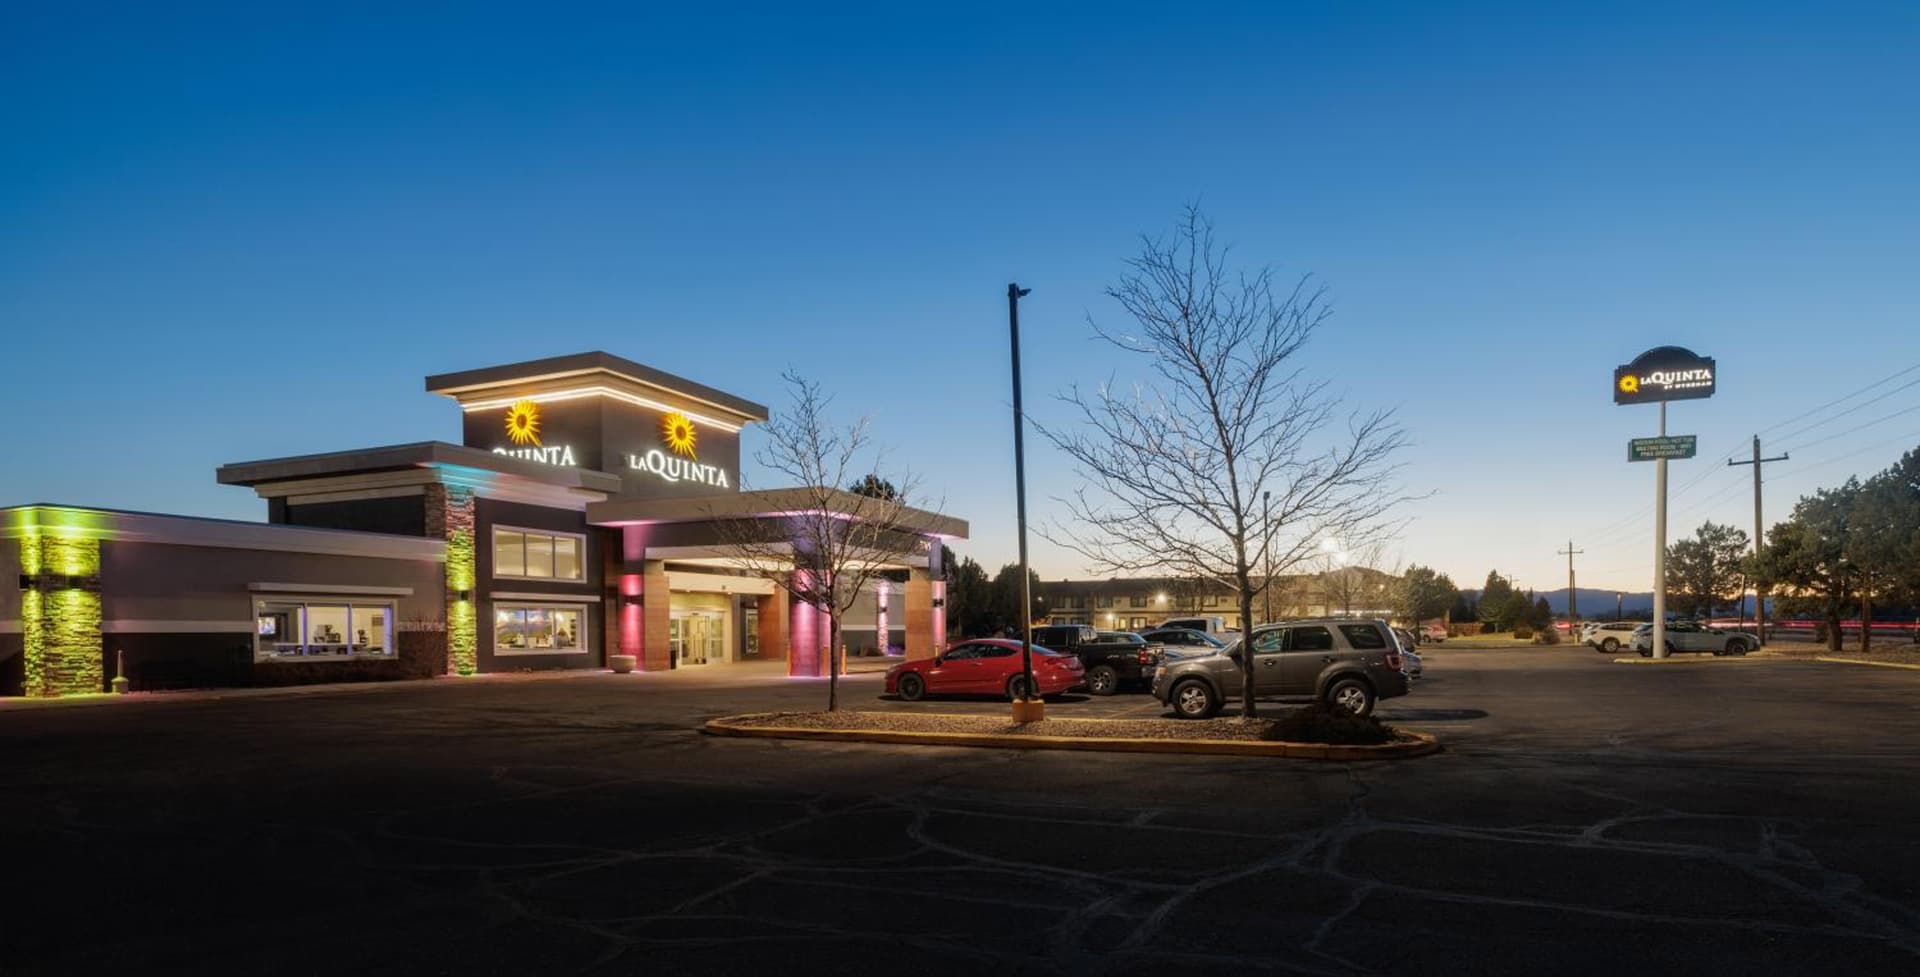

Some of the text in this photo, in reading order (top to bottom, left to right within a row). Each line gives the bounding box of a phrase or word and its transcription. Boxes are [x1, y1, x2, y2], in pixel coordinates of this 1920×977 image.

[1651, 369, 1712, 385] QUINTA
[630, 449, 729, 488] LA QUINTA
